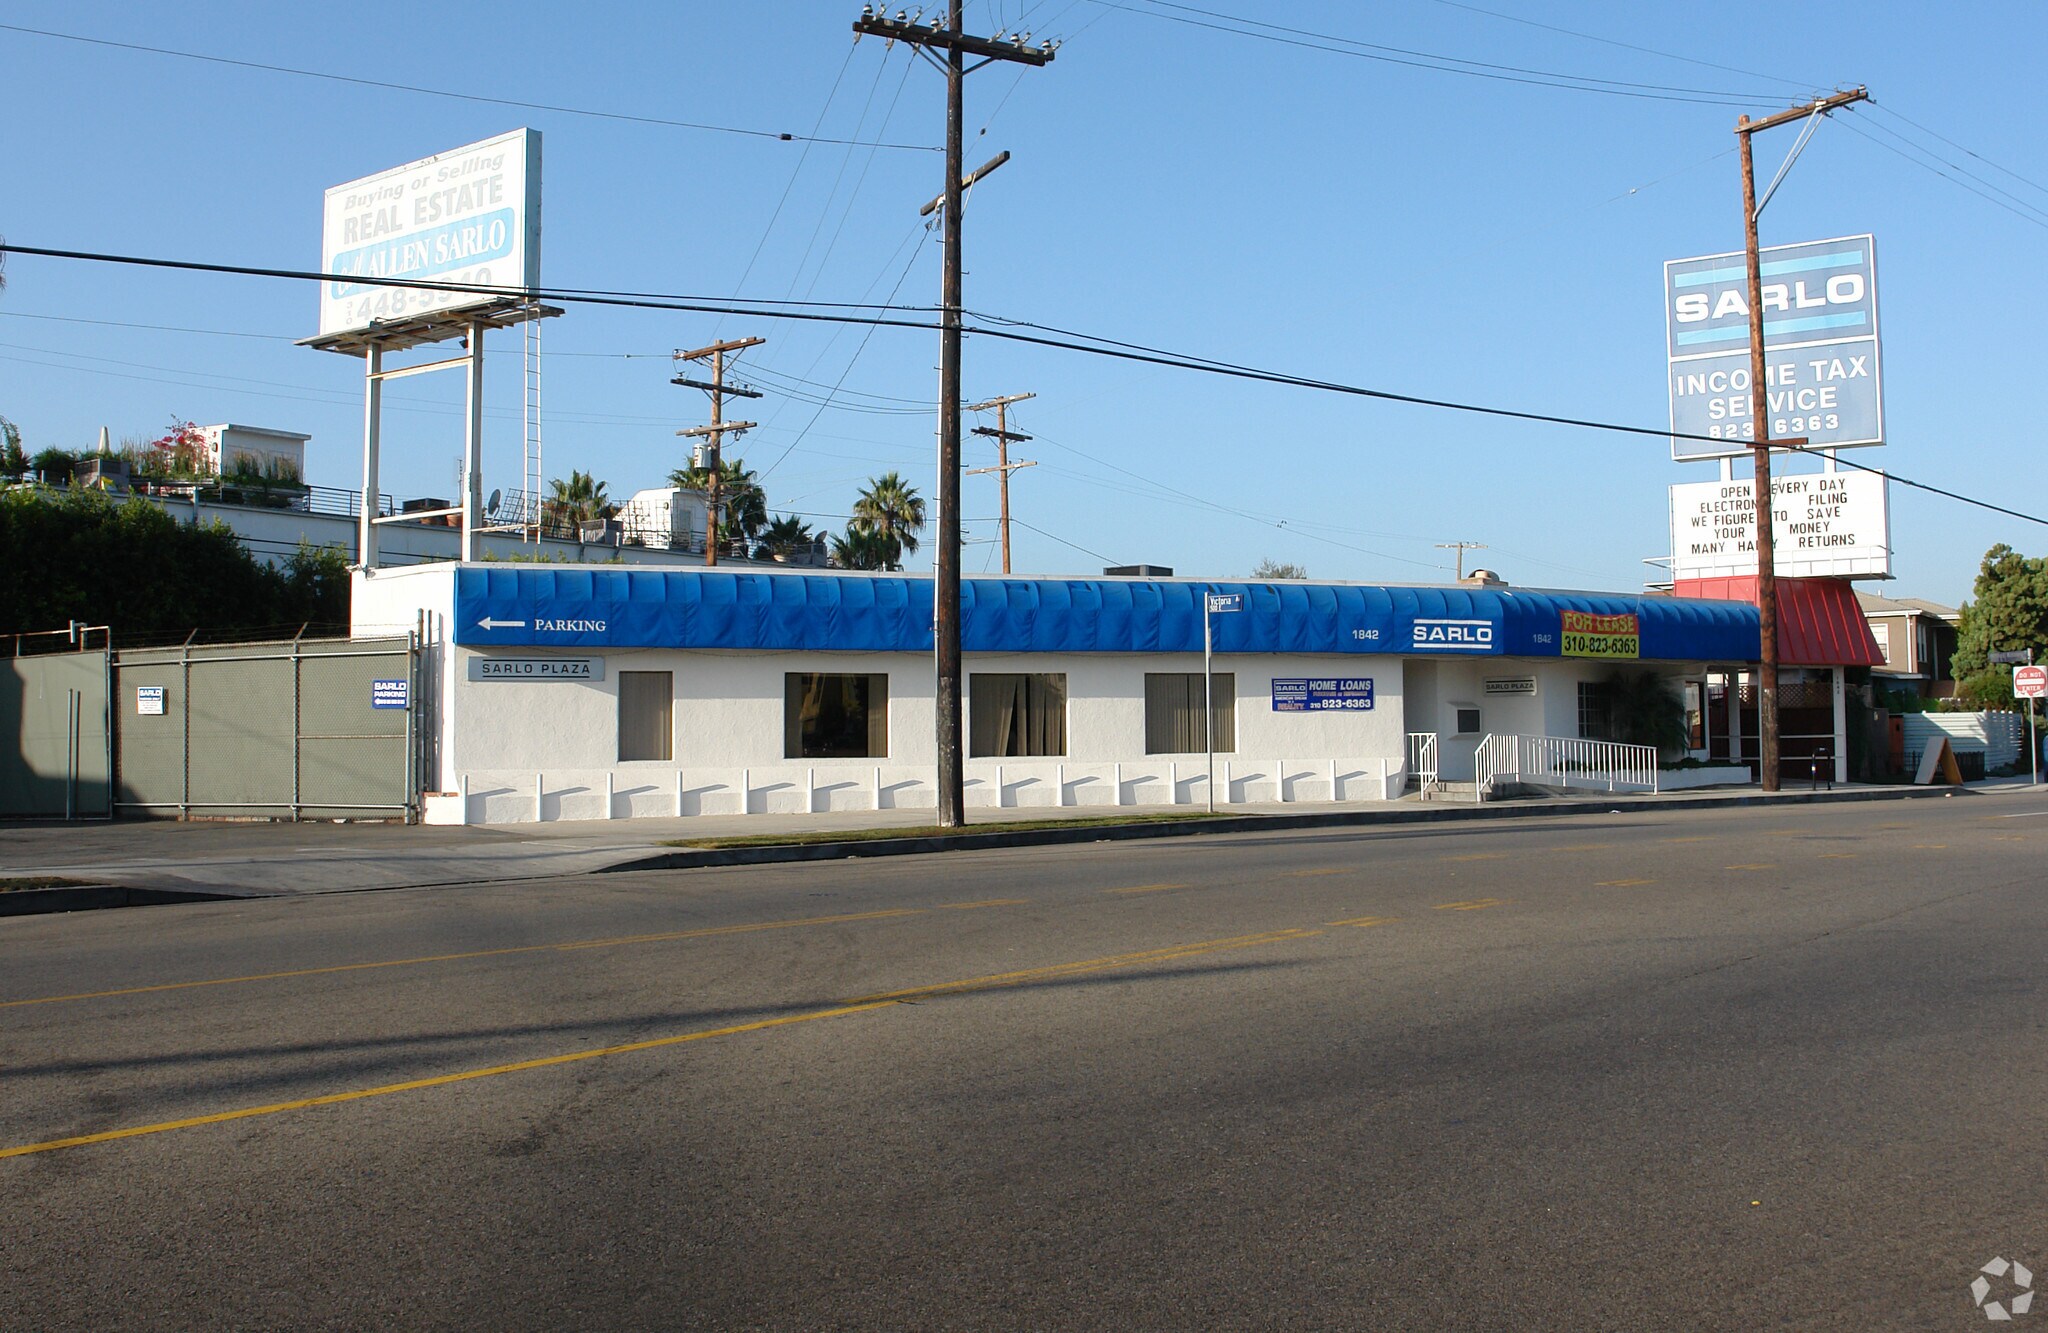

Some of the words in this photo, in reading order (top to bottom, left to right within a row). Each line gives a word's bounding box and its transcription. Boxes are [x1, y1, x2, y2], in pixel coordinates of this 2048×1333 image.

[344, 183, 404, 210] Buying
[411, 176, 430, 191] or
[437, 153, 505, 182] Selling
[343, 205, 402, 245] REAL
[414, 174, 503, 225] ESTATE
[367, 239, 430, 277] ALLEN
[435, 219, 506, 264] SARLO
[1675, 273, 1865, 323] SARLO
[1809, 356, 1868, 381] TAX
[1708, 386, 1838, 420] SEVICE
[1721, 486, 1750, 498] OPEN
[1771, 481, 1808, 494] EVERY
[1820, 478, 1845, 491] DAY
[1808, 492, 1847, 505] FILING
[1691, 516, 1707, 527] WE
[1714, 513, 1755, 526] FIGURE
[1773, 511, 1788, 521] TO
[1807, 506, 1840, 520] SAVE
[1714, 527, 1745, 539] YOUR
[1789, 521, 1830, 534] MONEY
[1691, 542, 1725, 554] MANY
[1738, 539, 1778, 551] HAY
[1799, 534, 1855, 548] RETURNS
[534, 619, 606, 632] PARKING
[1563, 613, 1593, 630] FOR
[1596, 616, 1634, 632] LEASE
[1352, 629, 1379, 640] 1842
[1413, 626, 1492, 642] SARLO
[1533, 634, 1552, 643] 1842
[482, 664, 533, 674] SARLO
[541, 664, 590, 674] PLAZA
[374, 682, 407, 690] SARLO
[1309, 680, 1337, 691] HOME
[1340, 680, 1371, 690] LOANS
[1322, 699, 1371, 708] 823-6363
